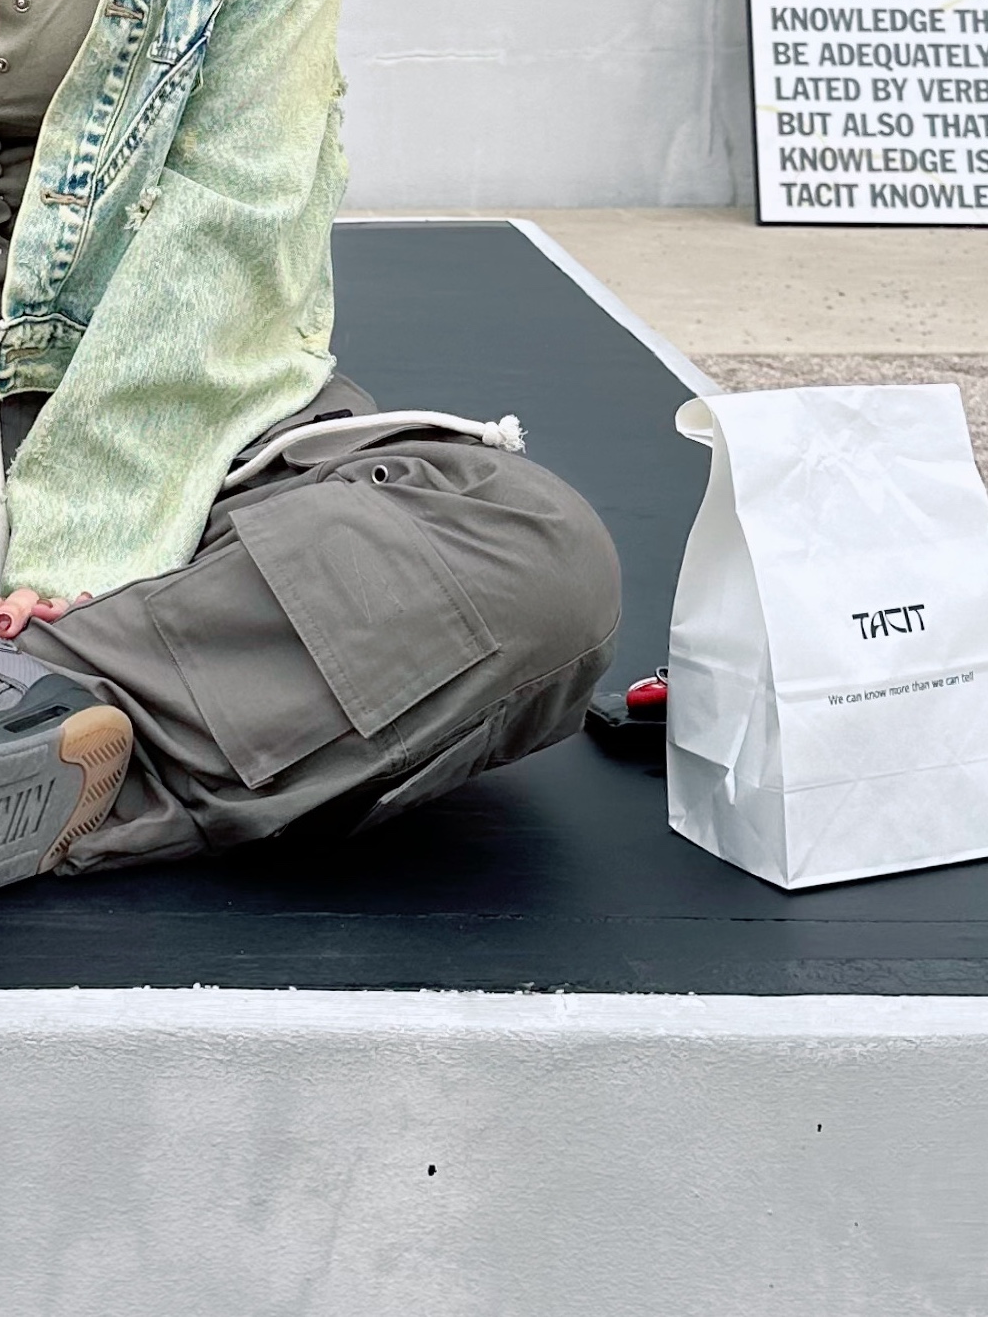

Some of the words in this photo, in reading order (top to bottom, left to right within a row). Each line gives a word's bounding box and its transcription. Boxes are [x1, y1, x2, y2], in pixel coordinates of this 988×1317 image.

[771, 7, 945, 32] KNOWLEDGE
[773, 42, 809, 66] BE
[775, 77, 860, 101] LATED
[872, 78, 907, 101] BY
[918, 79, 988, 103] VERB
[777, 112, 831, 136] BUT
[843, 113, 914, 137] ALSO
[780, 147, 956, 173] KNOWLEDGE
[780, 182, 858, 207] TACIT
[870, 183, 988, 209] KNOWLE
[852, 604, 925, 640] TACIT
[828, 694, 844, 706] We
[846, 693, 862, 703] can
[864, 689, 887, 700] know
[889, 685, 910, 696] more
[912, 680, 930, 692] than
[932, 678, 944, 688] we
[945, 676, 960, 686] can
[961, 670, 974, 683] tell
